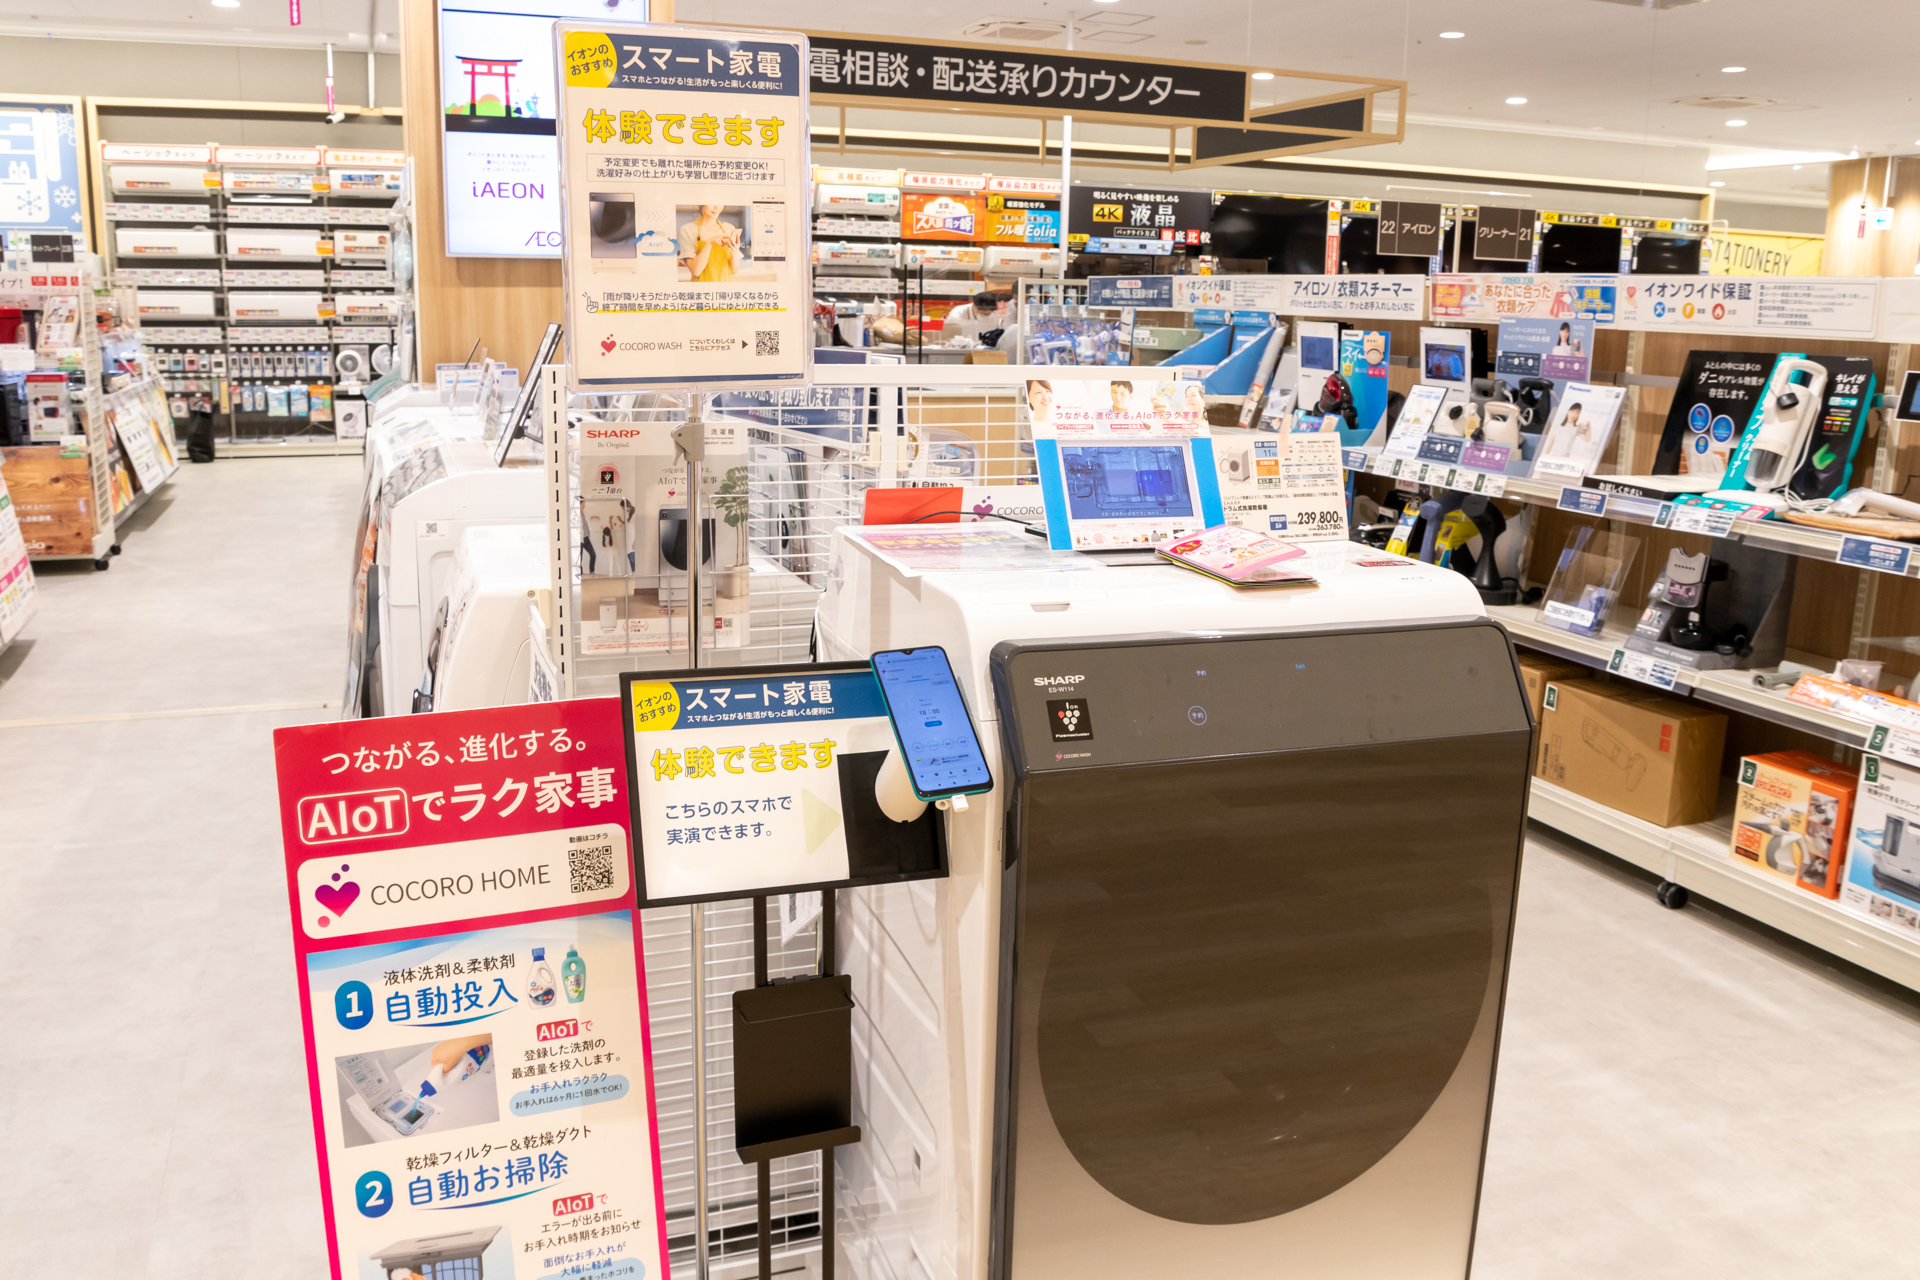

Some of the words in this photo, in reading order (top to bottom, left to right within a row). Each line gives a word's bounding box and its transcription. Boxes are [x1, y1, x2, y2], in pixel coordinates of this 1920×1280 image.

[567, 43, 609, 62] イオンの
[622, 44, 782, 78] スマート家電
[570, 59, 614, 76] おすすめ
[582, 108, 785, 148] 体験できます
[596, 167, 776, 182] 洗濯好みの仕上がりも学習し理想に近づけます
[472, 181, 544, 199] iAEON
[1095, 206, 1121, 221] 4K
[1130, 203, 1176, 227] 液晶
[1381, 220, 1396, 235] 22
[1401, 222, 1437, 236] アイロン
[1479, 226, 1517, 239] クリーナー
[1519, 227, 1532, 242] 21
[1485, 283, 1552, 299] あなたに合った
[1644, 282, 1753, 300] イオンワイド保証
[1496, 299, 1536, 314] 衣類ケア
[619, 341, 656, 351] COCORO
[658, 341, 682, 350] WASH
[1708, 387, 1749, 400] 存在します。
[586, 429, 641, 439] SHARP
[710, 428, 735, 436] 洗濯機
[605, 441, 630, 449] Original.
[997, 506, 1044, 516] COCORO
[1033, 674, 1086, 686] SHARP
[1048, 686, 1075, 694] ES-W114
[635, 690, 672, 711] イオンの
[686, 680, 833, 711] スマート家電
[639, 703, 677, 723] おすすめ
[1874, 733, 1882, 744] 2
[321, 727, 587, 775] つながる、進化する。
[650, 738, 837, 782] 体験できます
[1746, 767, 1753, 777] 2
[665, 795, 793, 820] こちらのスマホで
[569, 832, 609, 844] 動画はコチラ
[666, 822, 772, 846] 実演できます。
[371, 874, 474, 906] COCORO
[481, 864, 551, 892] HOME
[383, 952, 516, 987] 液体洗剤&柔軟剤
[345, 991, 364, 1019] 1
[386, 977, 519, 1023] 自動投入
[524, 1038, 606, 1061] 登録した洗剤の
[511, 1055, 622, 1080] 最適量を投入します。
[529, 1072, 608, 1094] お手入れラクラク
[405, 1124, 592, 1171] 乾燥フィルター&乾燥ダクト
[408, 1150, 569, 1206] 自動お掃除
[365, 1180, 383, 1208] 2
[541, 1208, 623, 1233] エラーが出る前に
[524, 1219, 641, 1253] お手入れ時期をお知らせ
[543, 1241, 626, 1268] 面倒なお手入れが
[560, 1258, 613, 1278] 大幅に軽減
